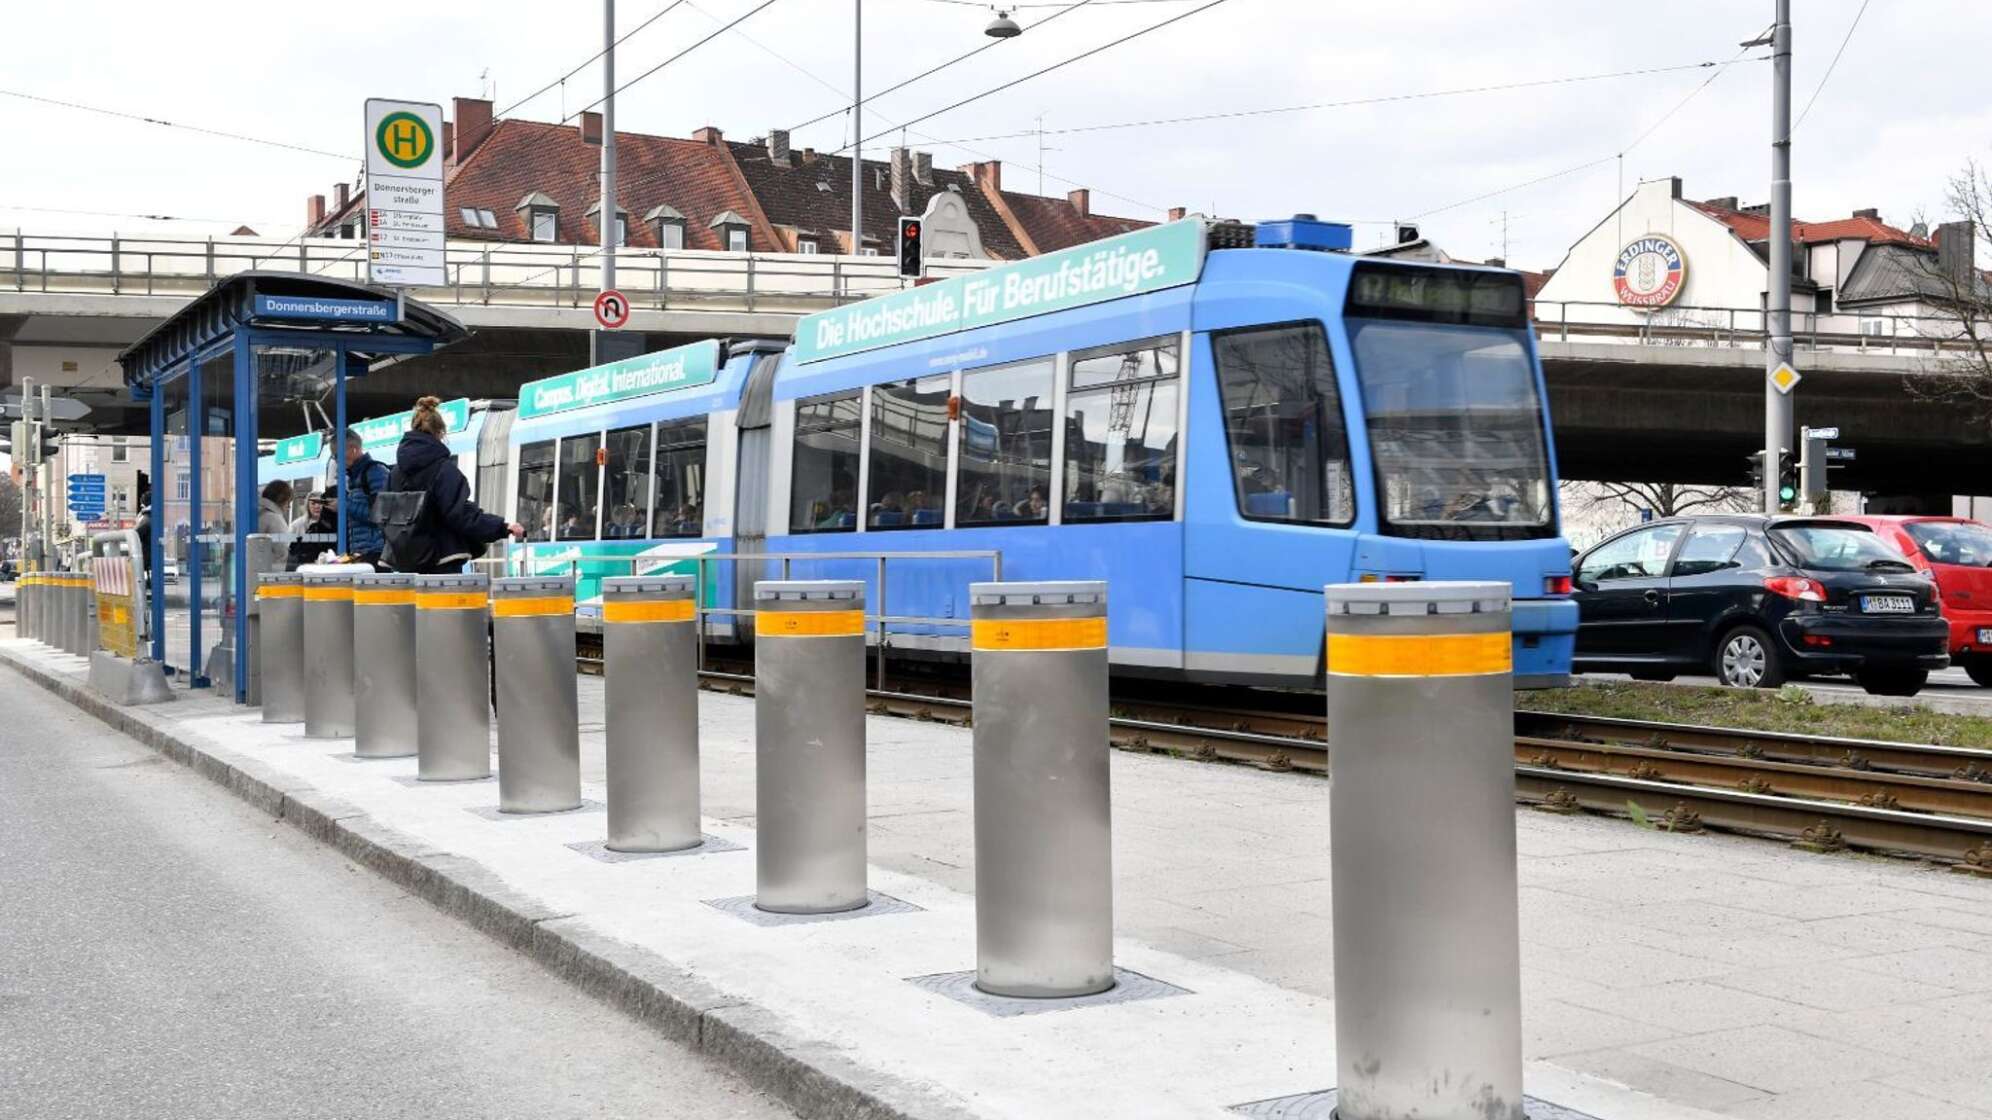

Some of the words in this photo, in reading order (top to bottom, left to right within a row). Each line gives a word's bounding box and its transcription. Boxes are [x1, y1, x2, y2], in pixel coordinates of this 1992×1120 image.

[393, 123, 417, 157] H
[374, 183, 435, 196] Donnersberger
[1617, 240, 1677, 271] ERDINGER
[266, 299, 387, 317] Donnersbergerstraße
[816, 317, 846, 350] Die
[847, 294, 959, 342] Hochschule.
[963, 276, 999, 318] Für
[1003, 246, 1164, 308] Berufstätige.
[575, 371, 610, 404] Digital.
[612, 354, 686, 393] International.
